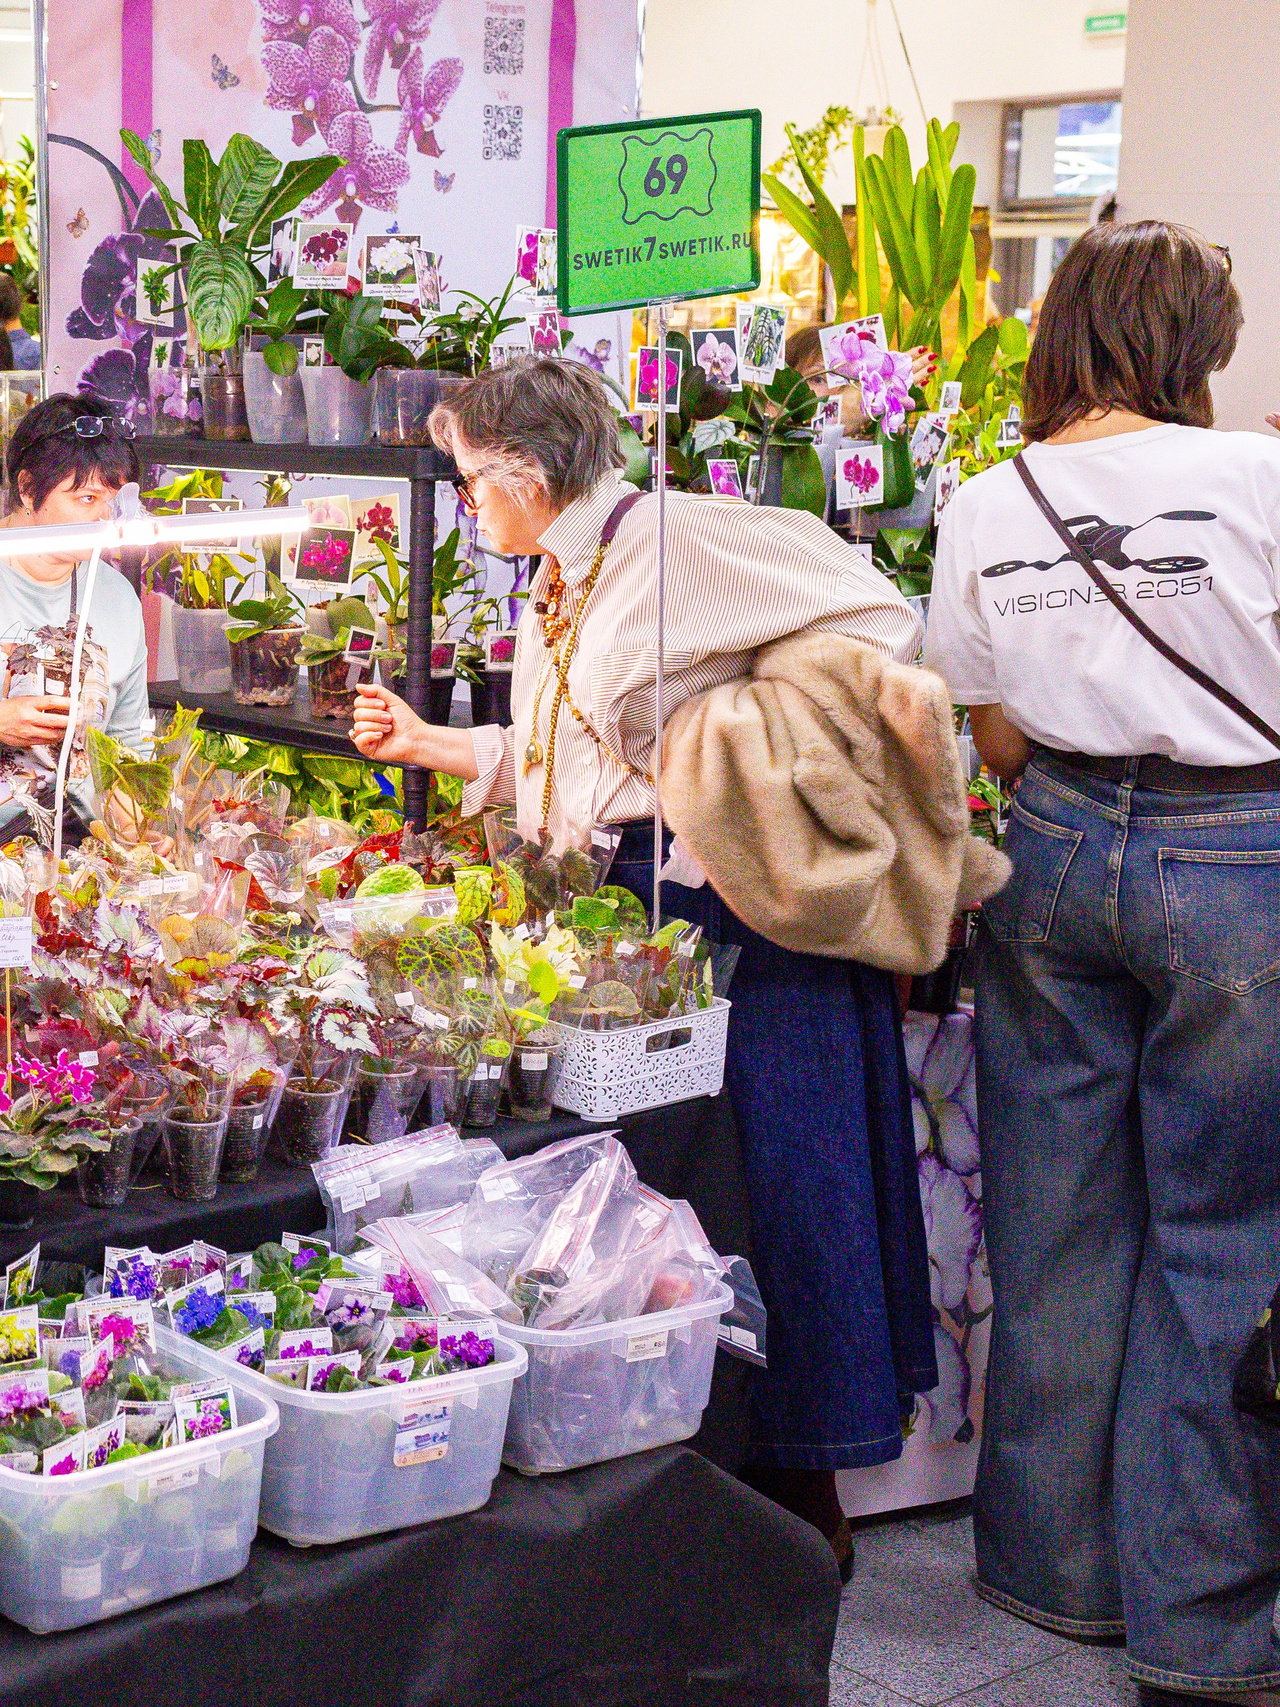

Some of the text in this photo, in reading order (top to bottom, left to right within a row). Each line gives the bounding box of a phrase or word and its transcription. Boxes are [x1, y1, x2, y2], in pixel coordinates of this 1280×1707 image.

[643, 153, 688, 198] 69
[573, 231, 752, 271] SWETIK7SWETIK.RU
[1136, 576, 1214, 600] 2051
